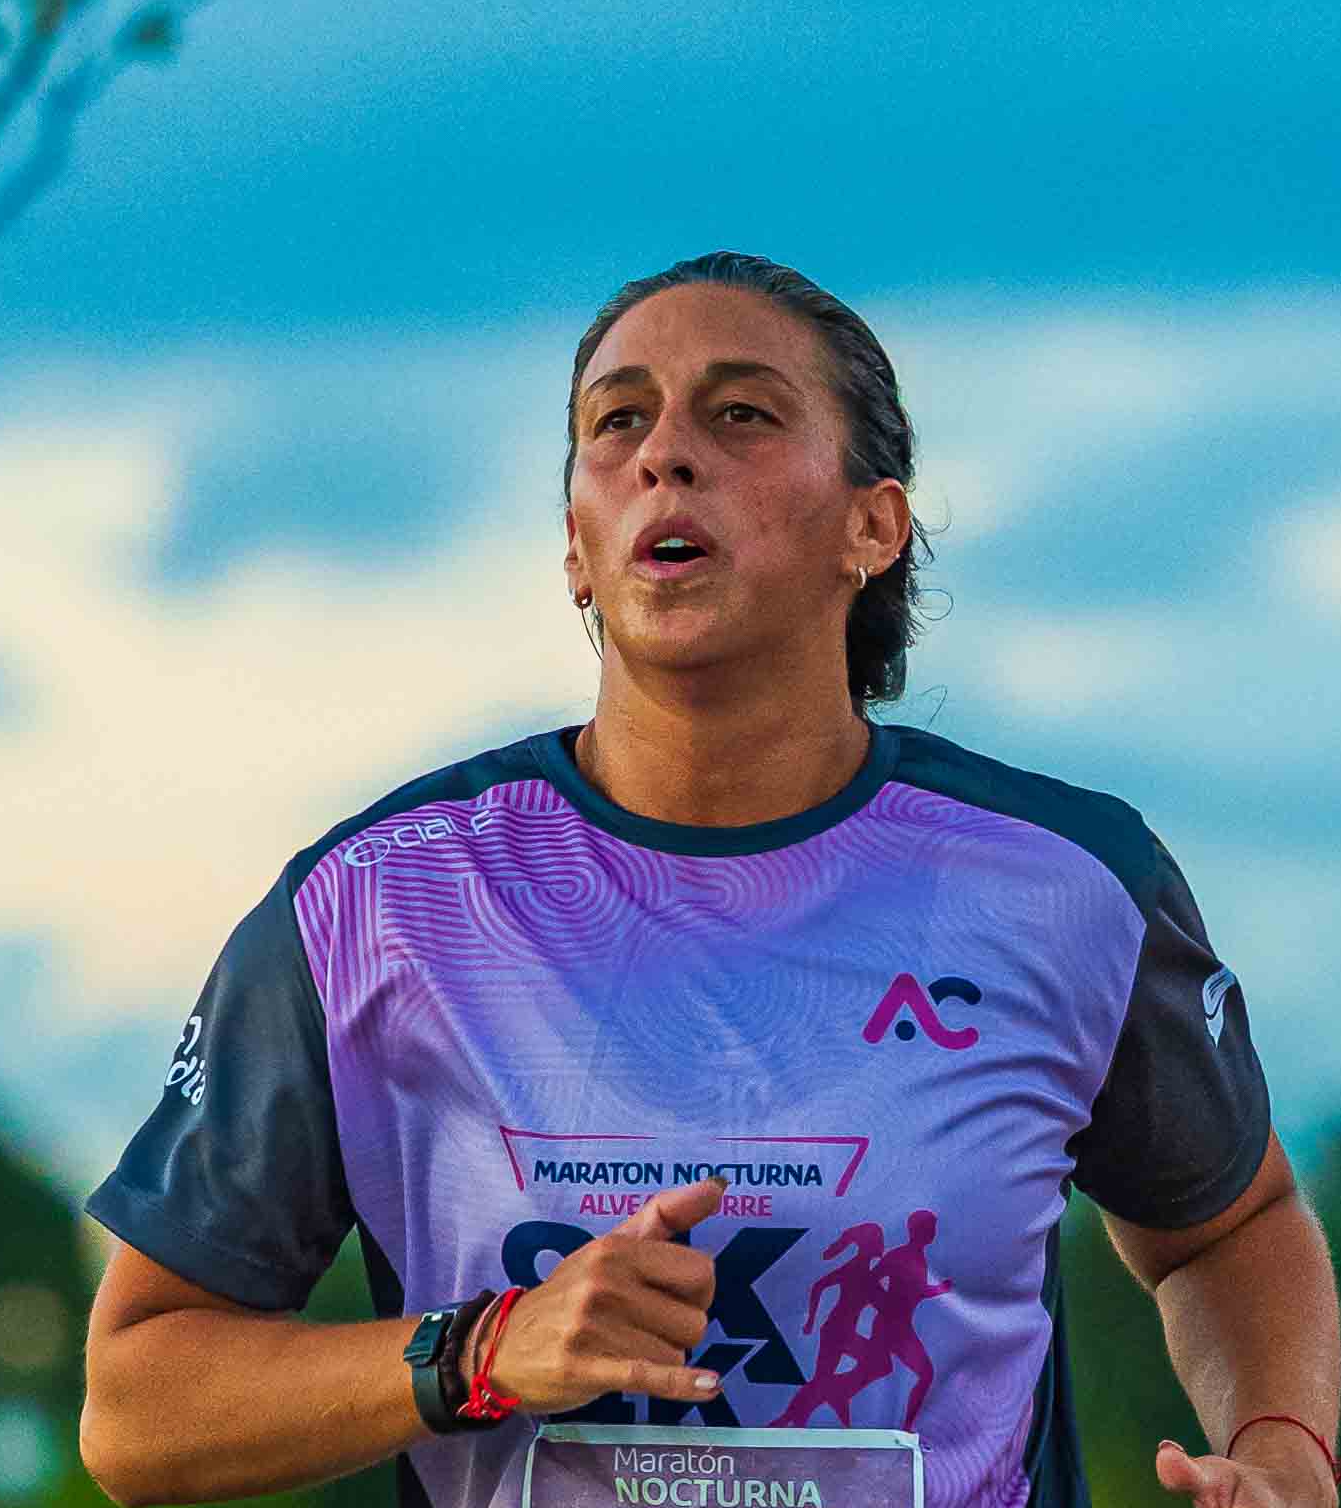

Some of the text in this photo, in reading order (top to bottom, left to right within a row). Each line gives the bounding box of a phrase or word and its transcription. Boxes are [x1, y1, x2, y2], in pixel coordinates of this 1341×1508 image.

[533, 1161, 823, 1187] MARATON NOCTURNA
[613, 1446, 735, 1475] Maratón
[614, 1478, 823, 1508] NOCTURNA
